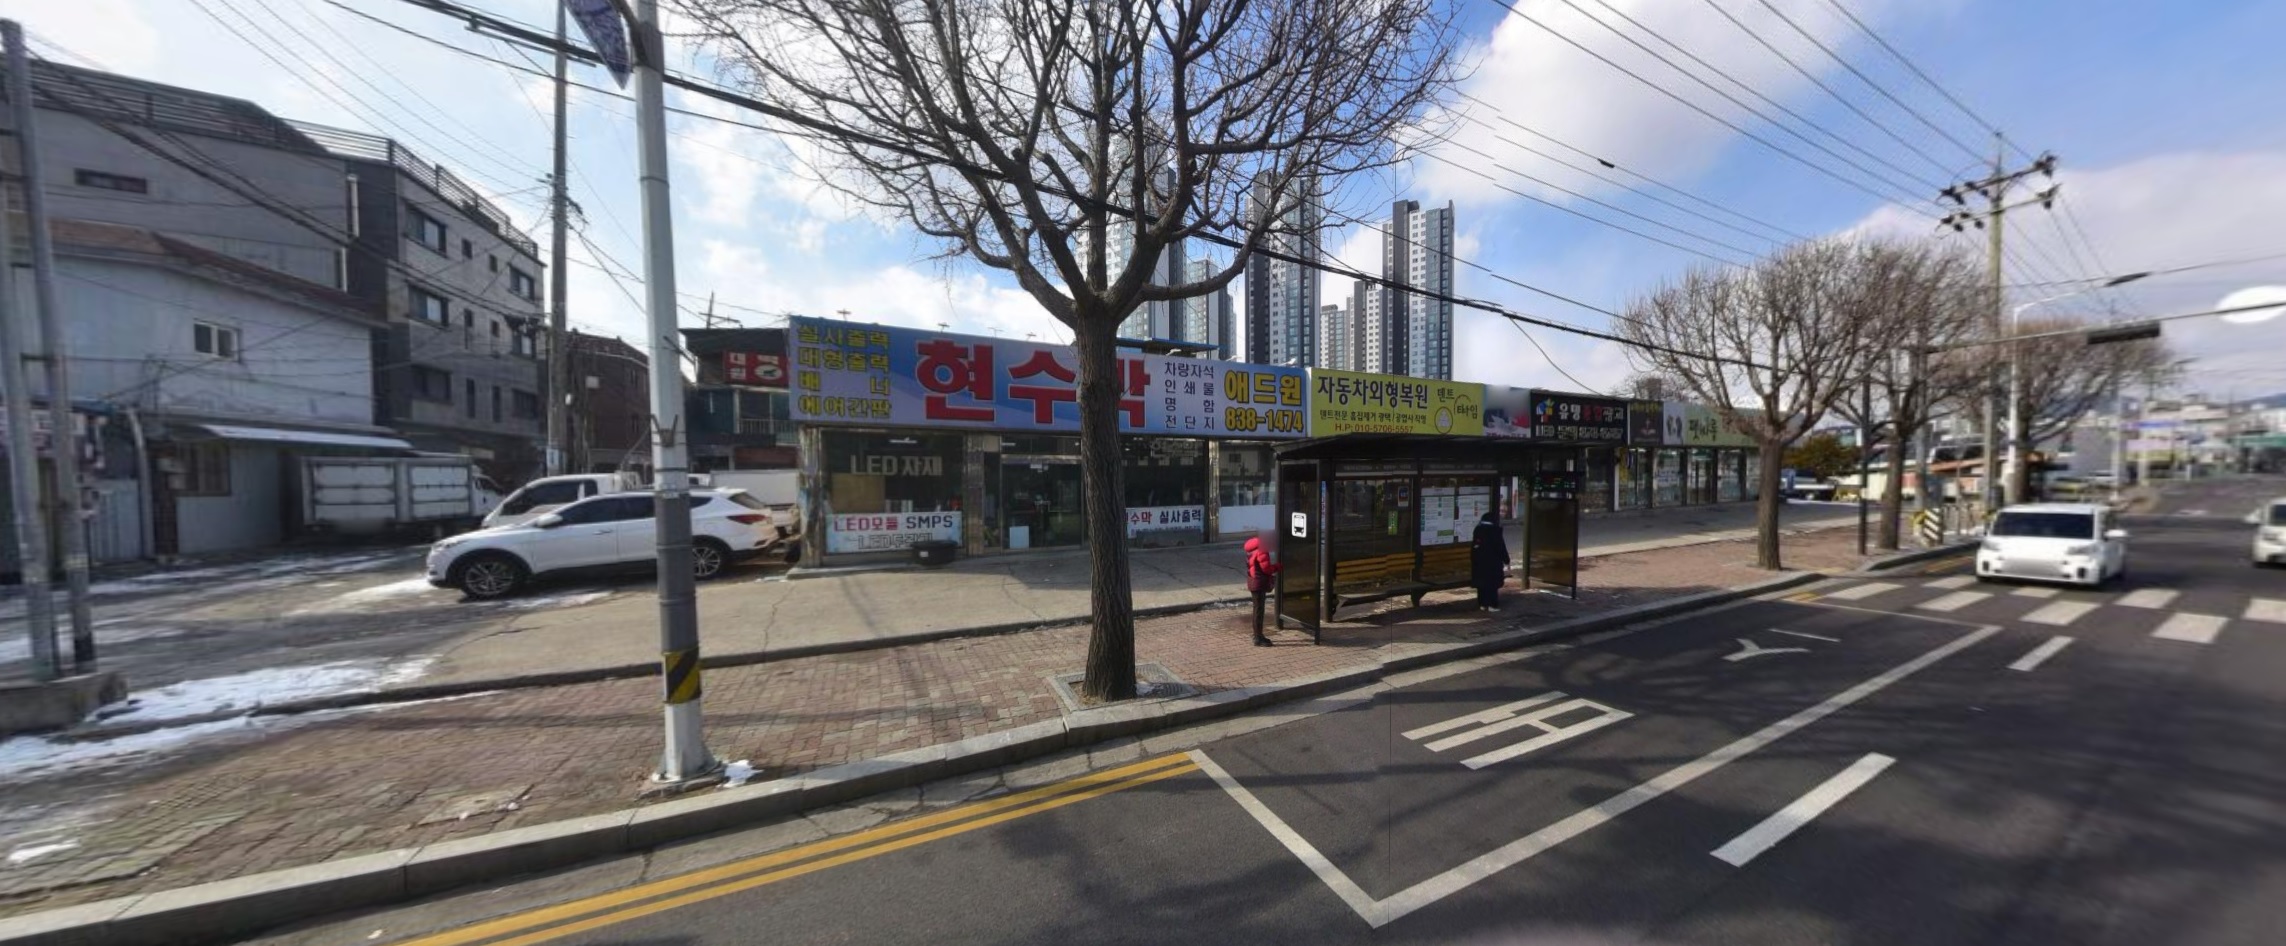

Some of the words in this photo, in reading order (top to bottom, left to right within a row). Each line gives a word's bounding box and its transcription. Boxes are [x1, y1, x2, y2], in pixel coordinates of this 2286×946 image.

[799, 348, 889, 373] 대형출력
[1165, 362, 1214, 379] 차량자석
[1224, 369, 1302, 406] 애드원
[799, 396, 891, 418] 에어간판
[1225, 406, 1304, 432] 838-1474
[834, 516, 898, 531] LED모듈
[906, 515, 953, 529] SMPS
[1123, 511, 1152, 524] 수막
[1160, 509, 1202, 524] 실사출력
